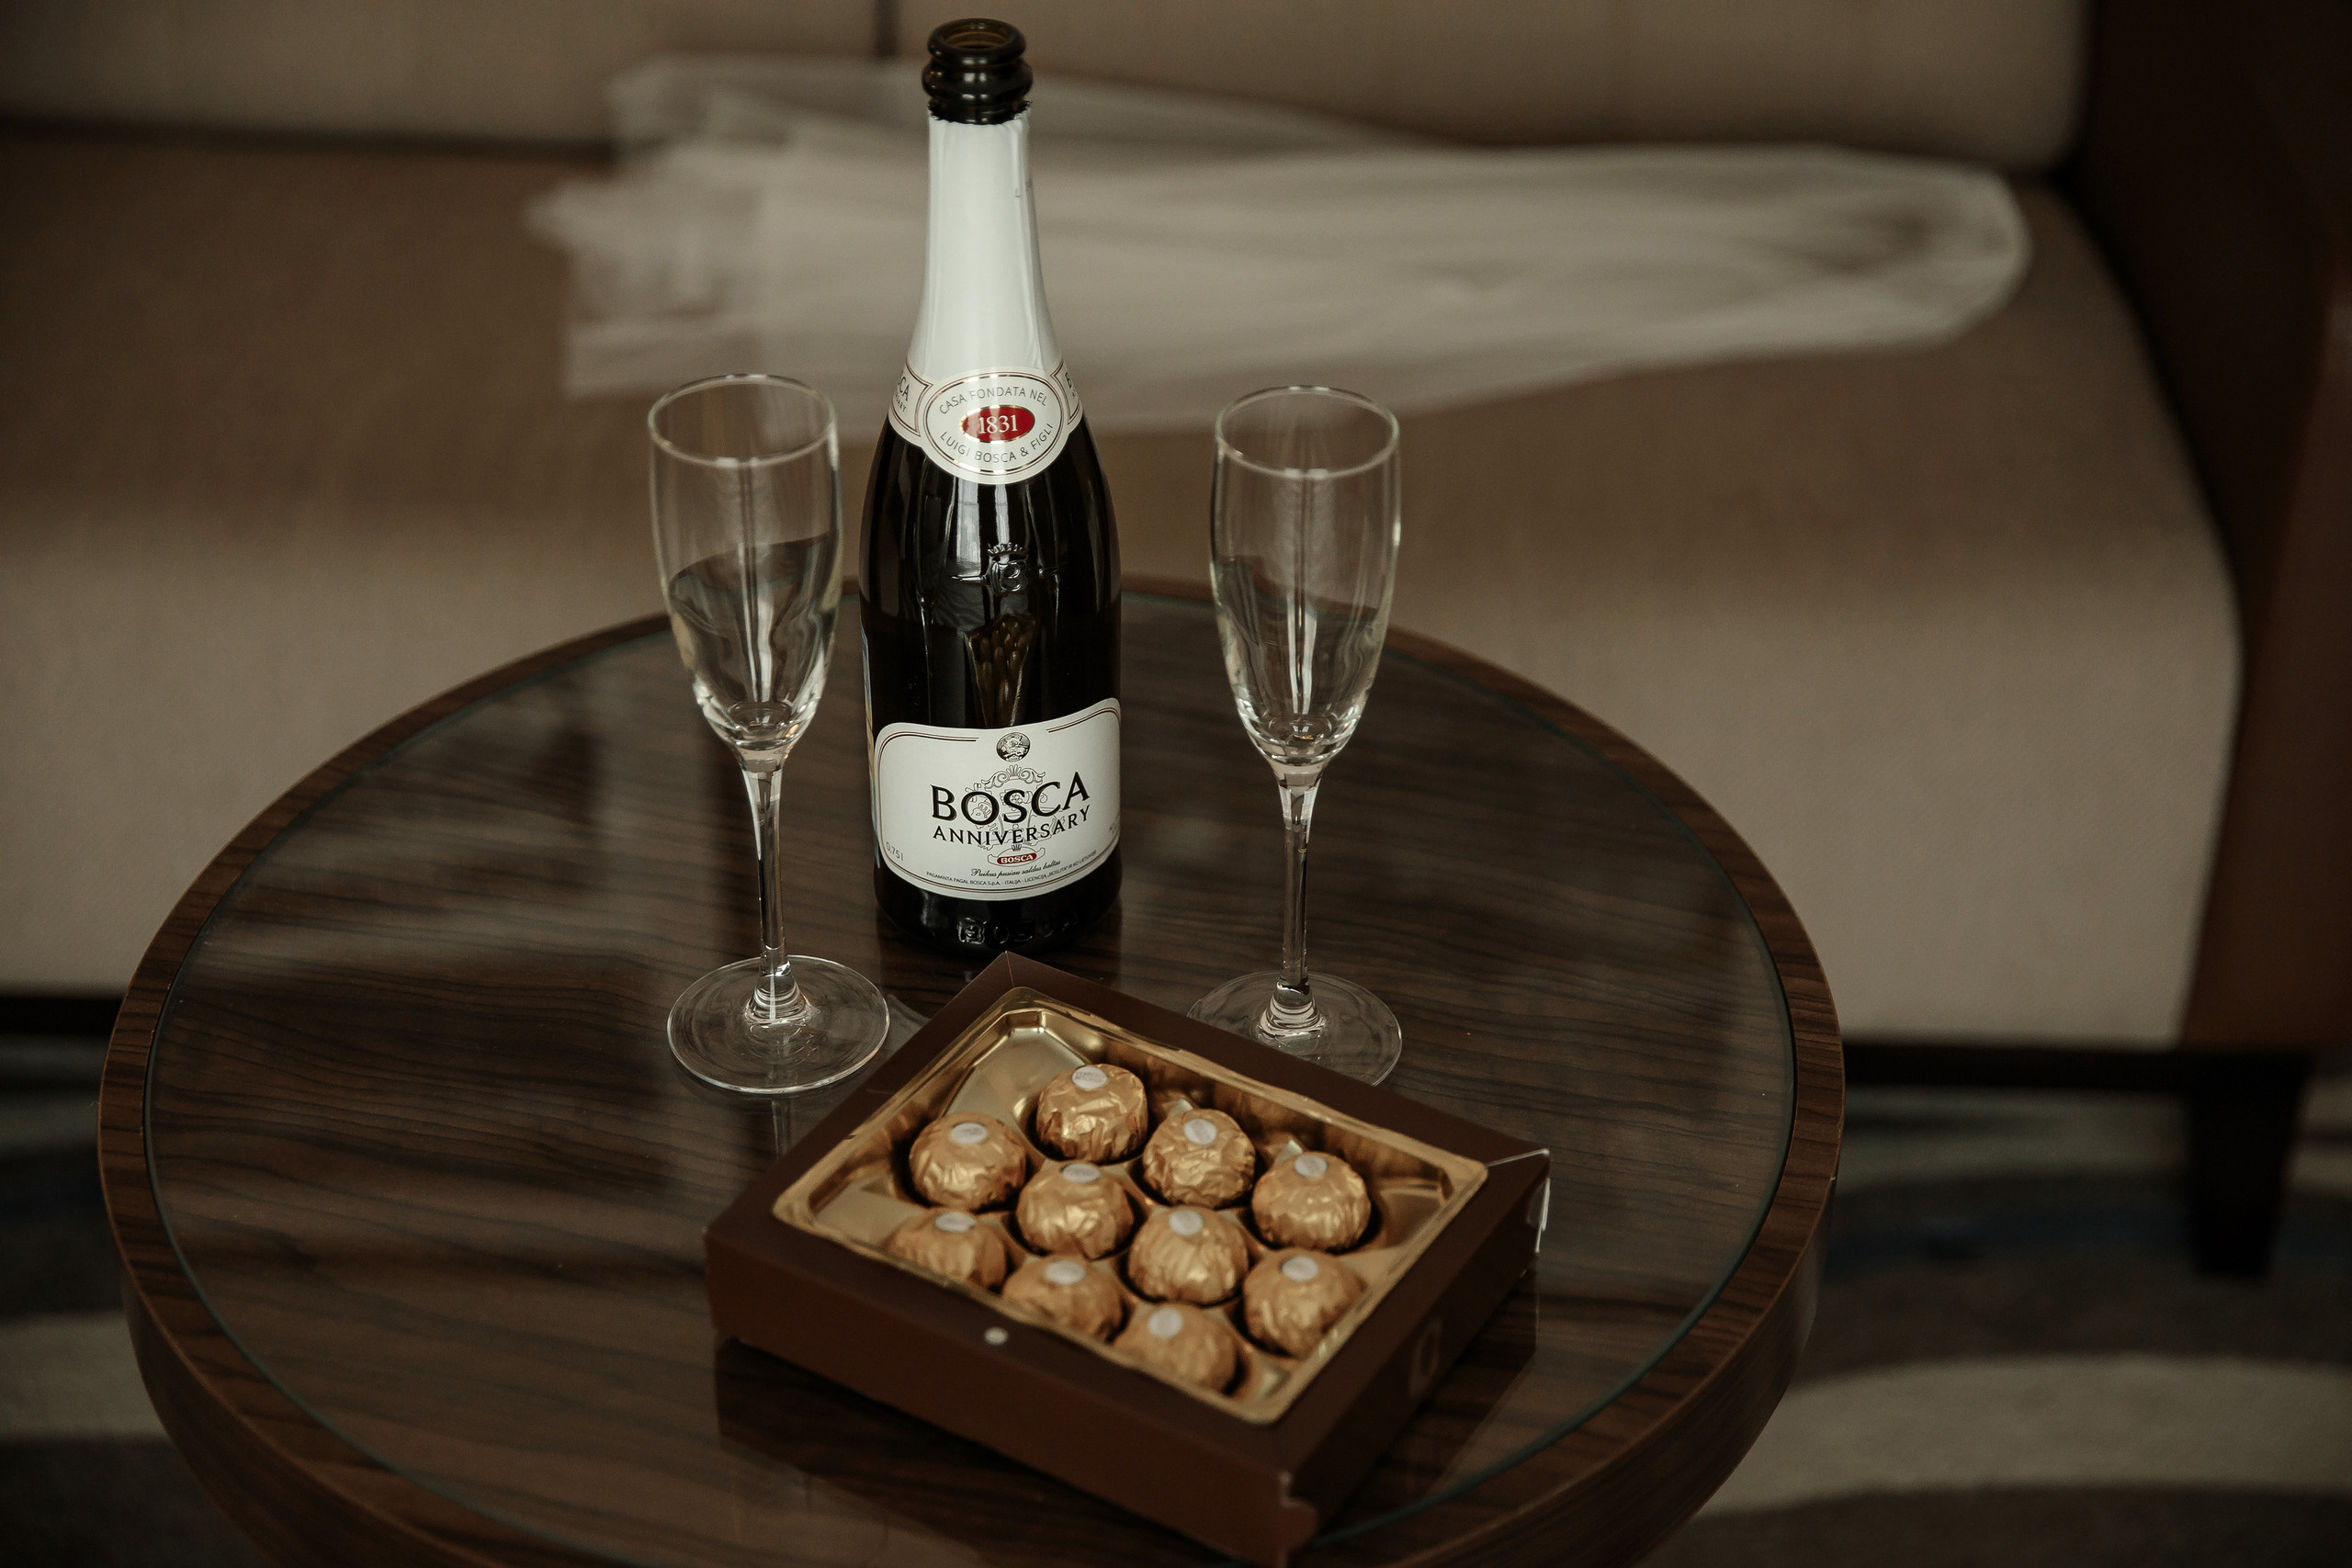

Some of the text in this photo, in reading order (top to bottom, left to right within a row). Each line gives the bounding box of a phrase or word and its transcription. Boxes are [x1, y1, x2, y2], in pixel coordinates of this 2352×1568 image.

[939, 386, 1047, 414] CASA FONDATA NEL
[978, 414, 1018, 434] 1831
[940, 423, 1053, 464] LUIGI BOSCA & FIGLI
[930, 771, 1091, 826] BOSCA
[933, 805, 1091, 846] ANNIVERSARY
[1001, 854, 1034, 864] BOSCA
